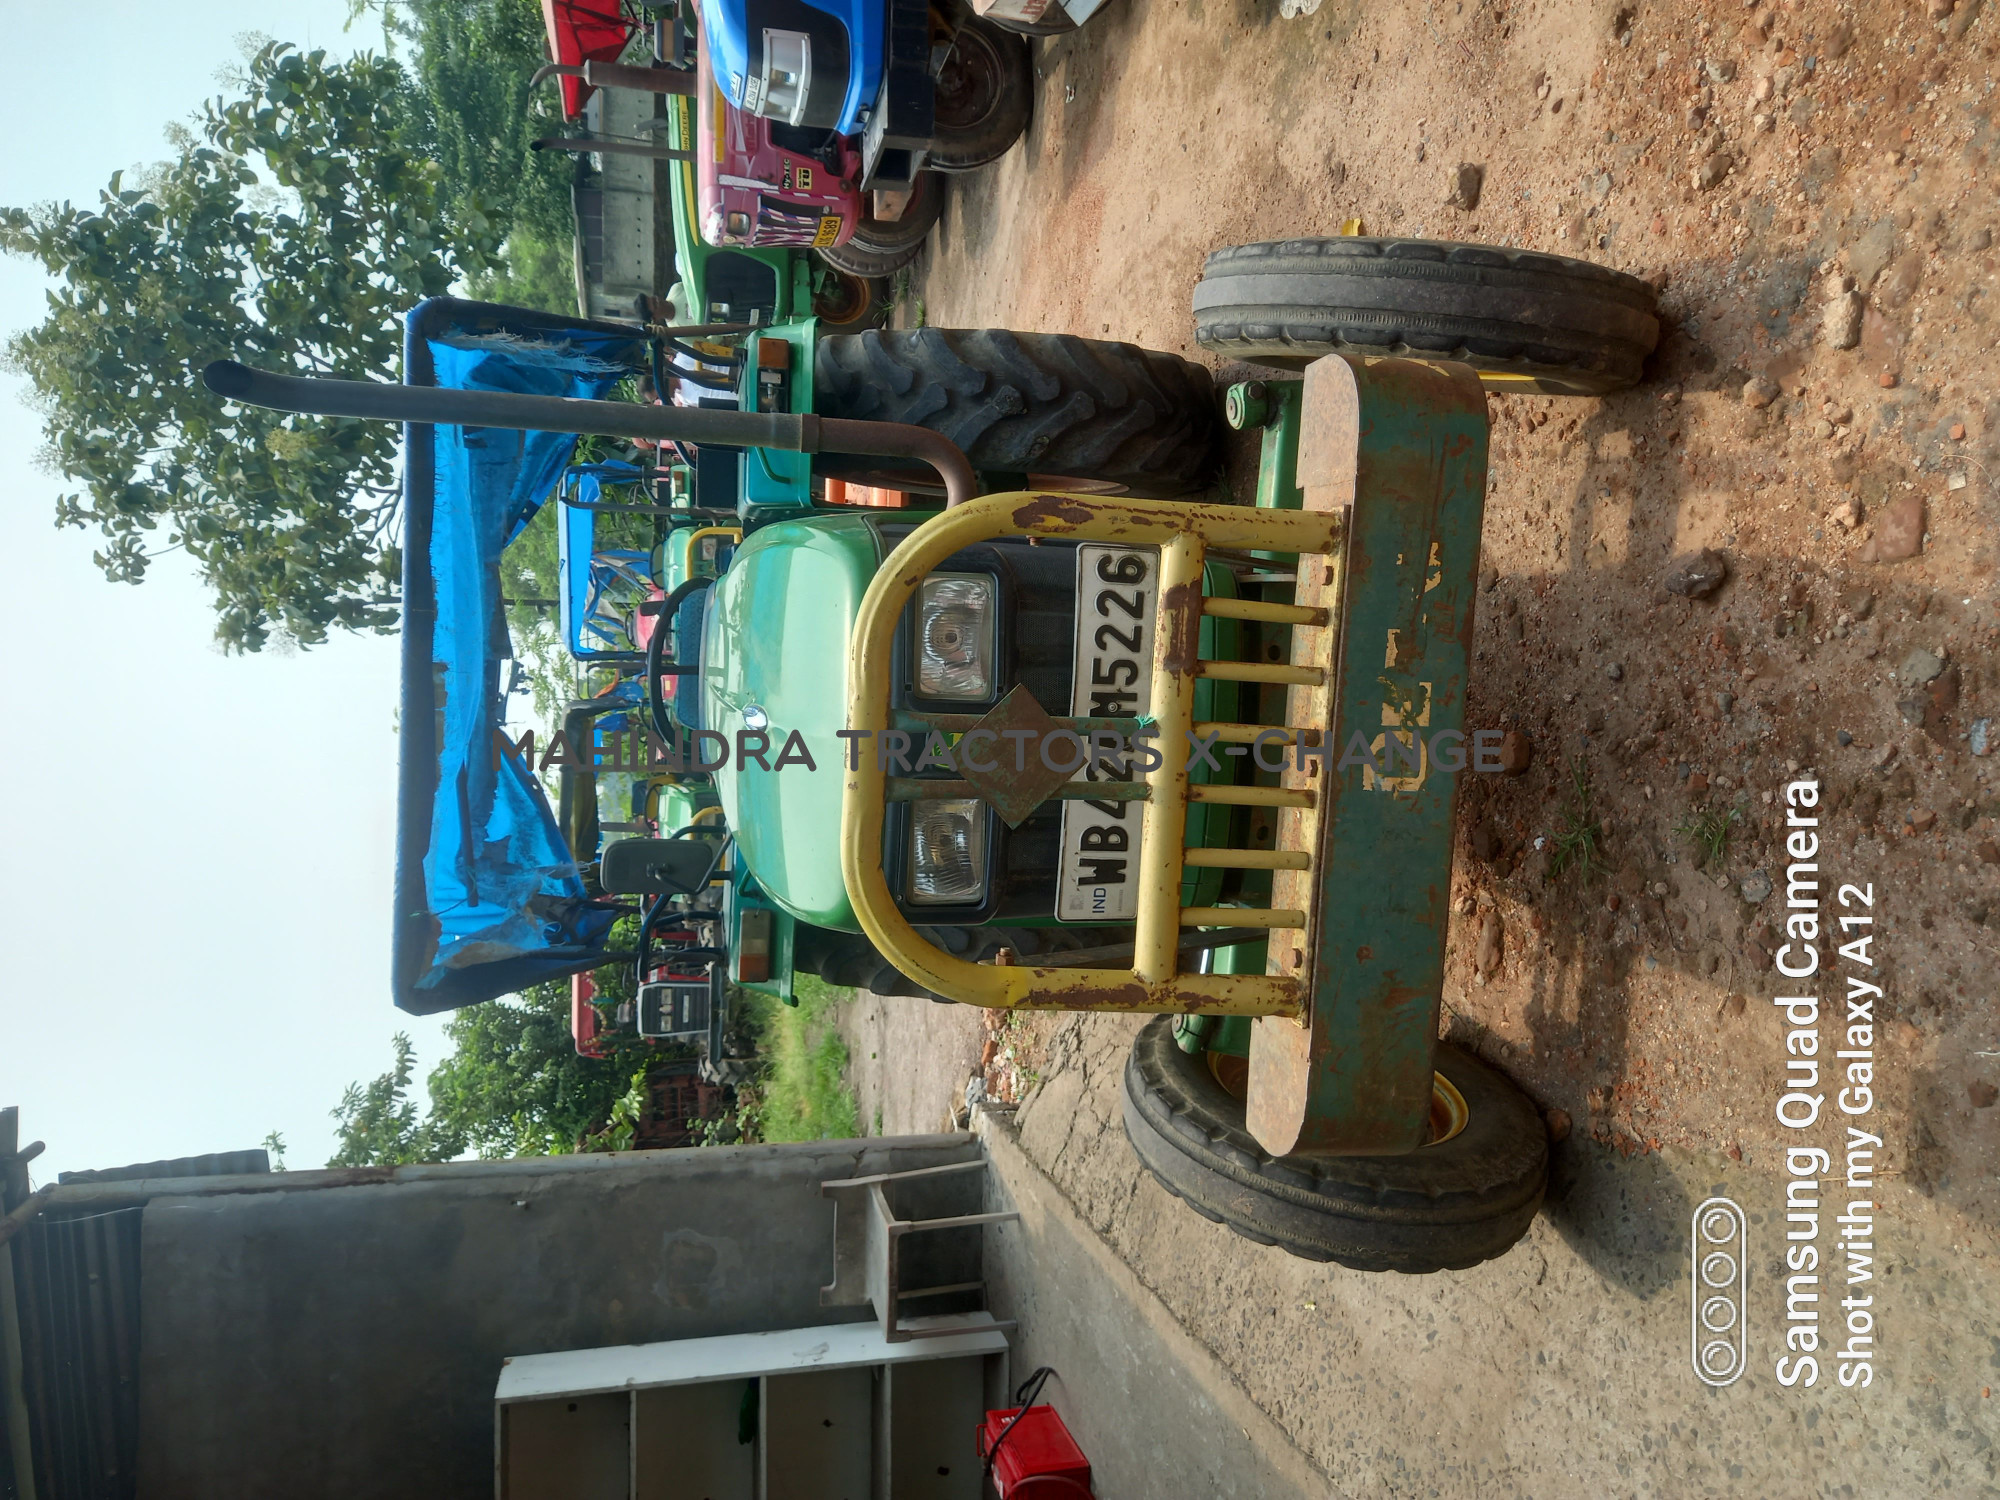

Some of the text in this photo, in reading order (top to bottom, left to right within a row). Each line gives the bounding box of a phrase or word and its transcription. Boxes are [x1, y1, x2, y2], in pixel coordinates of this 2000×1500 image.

[783, 158, 792, 190] Hy-TEC
[802, 168, 810, 188] TU
[1092, 887, 1107, 914] IND
